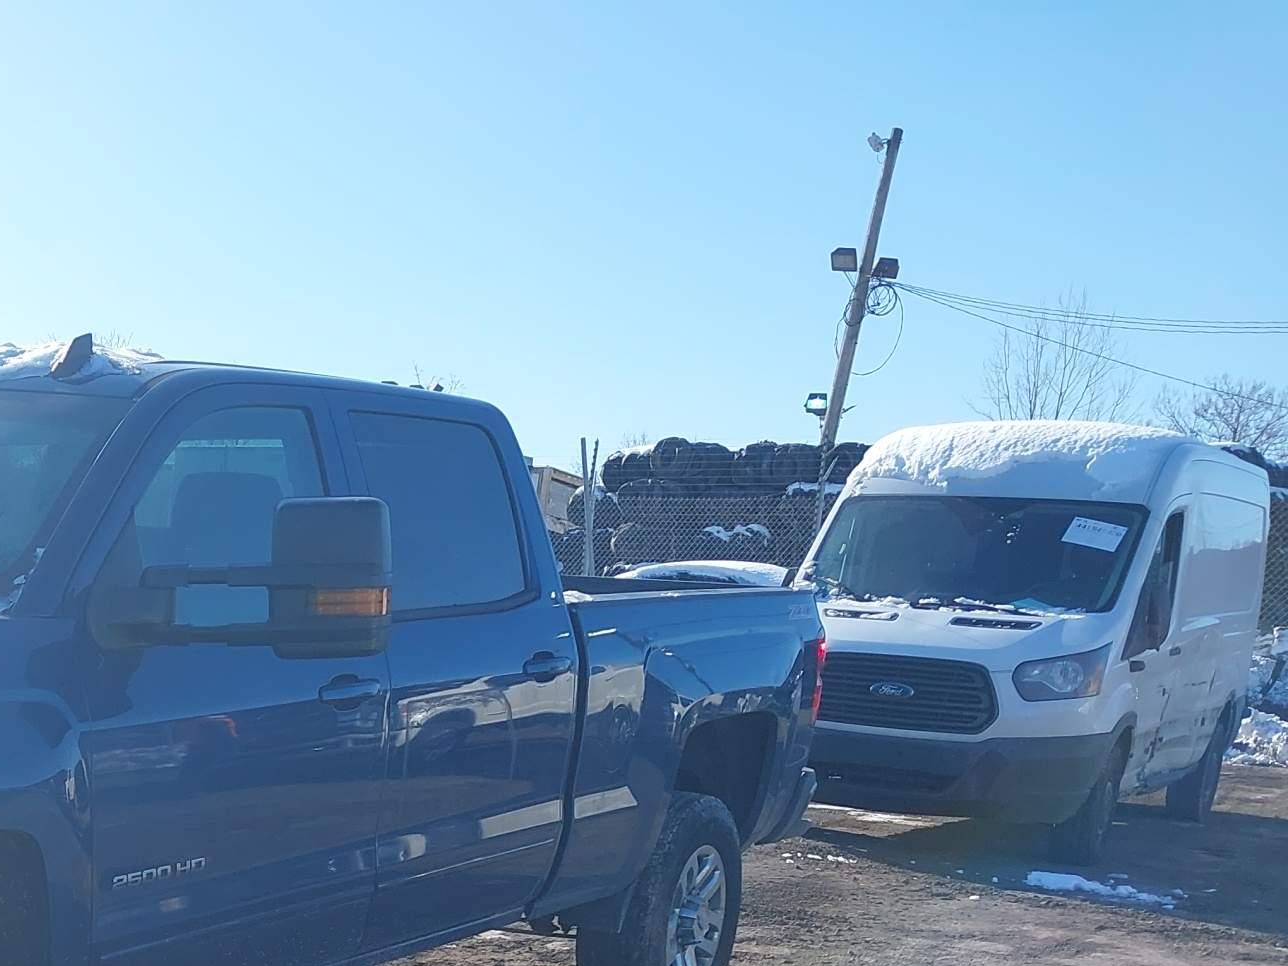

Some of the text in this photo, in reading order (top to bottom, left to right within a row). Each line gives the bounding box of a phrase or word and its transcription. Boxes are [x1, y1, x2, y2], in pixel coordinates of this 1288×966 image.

[878, 683, 904, 697] Ford
[112, 856, 207, 889] 2500 HD
